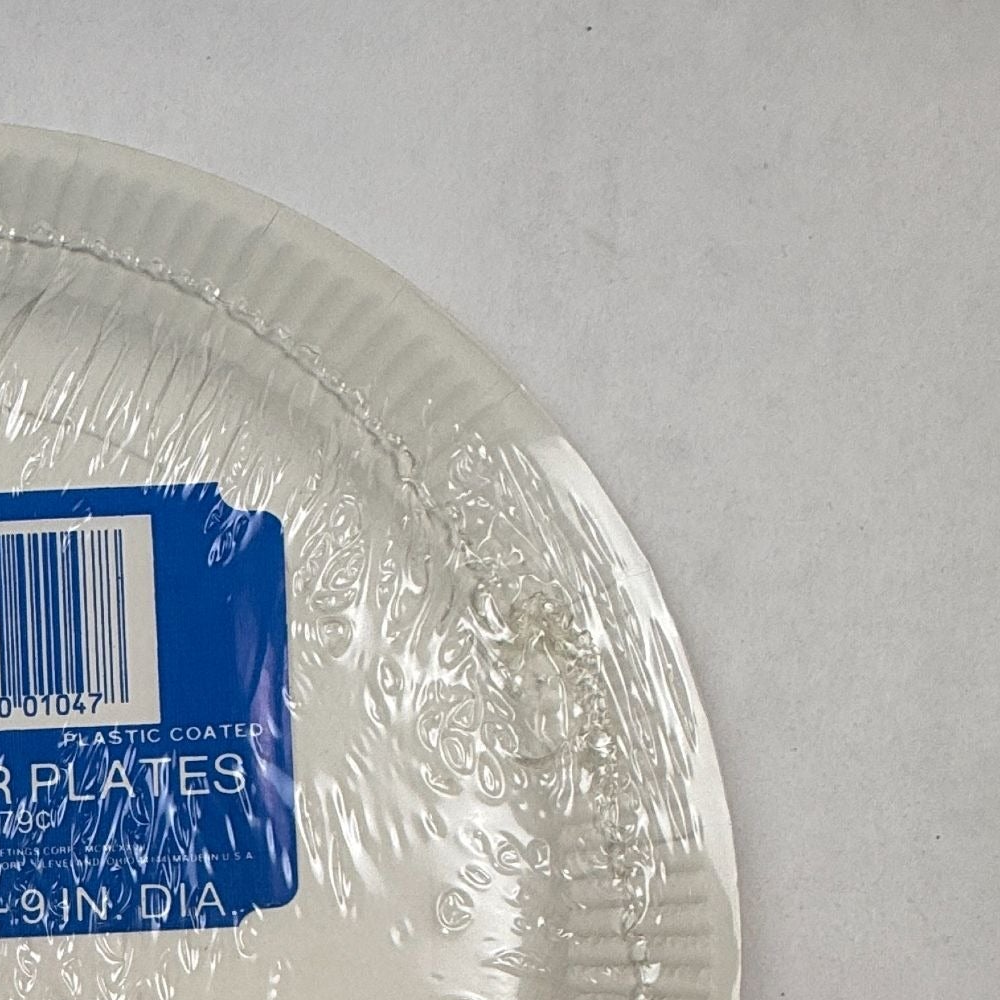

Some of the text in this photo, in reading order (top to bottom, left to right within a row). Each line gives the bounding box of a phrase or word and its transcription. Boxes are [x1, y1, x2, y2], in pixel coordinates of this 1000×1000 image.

[22, 693, 103, 717] 01047
[63, 723, 263, 747] PLASTIC COATED
[30, 752, 246, 803] PLATES
[20, 888, 46, 924] 9
